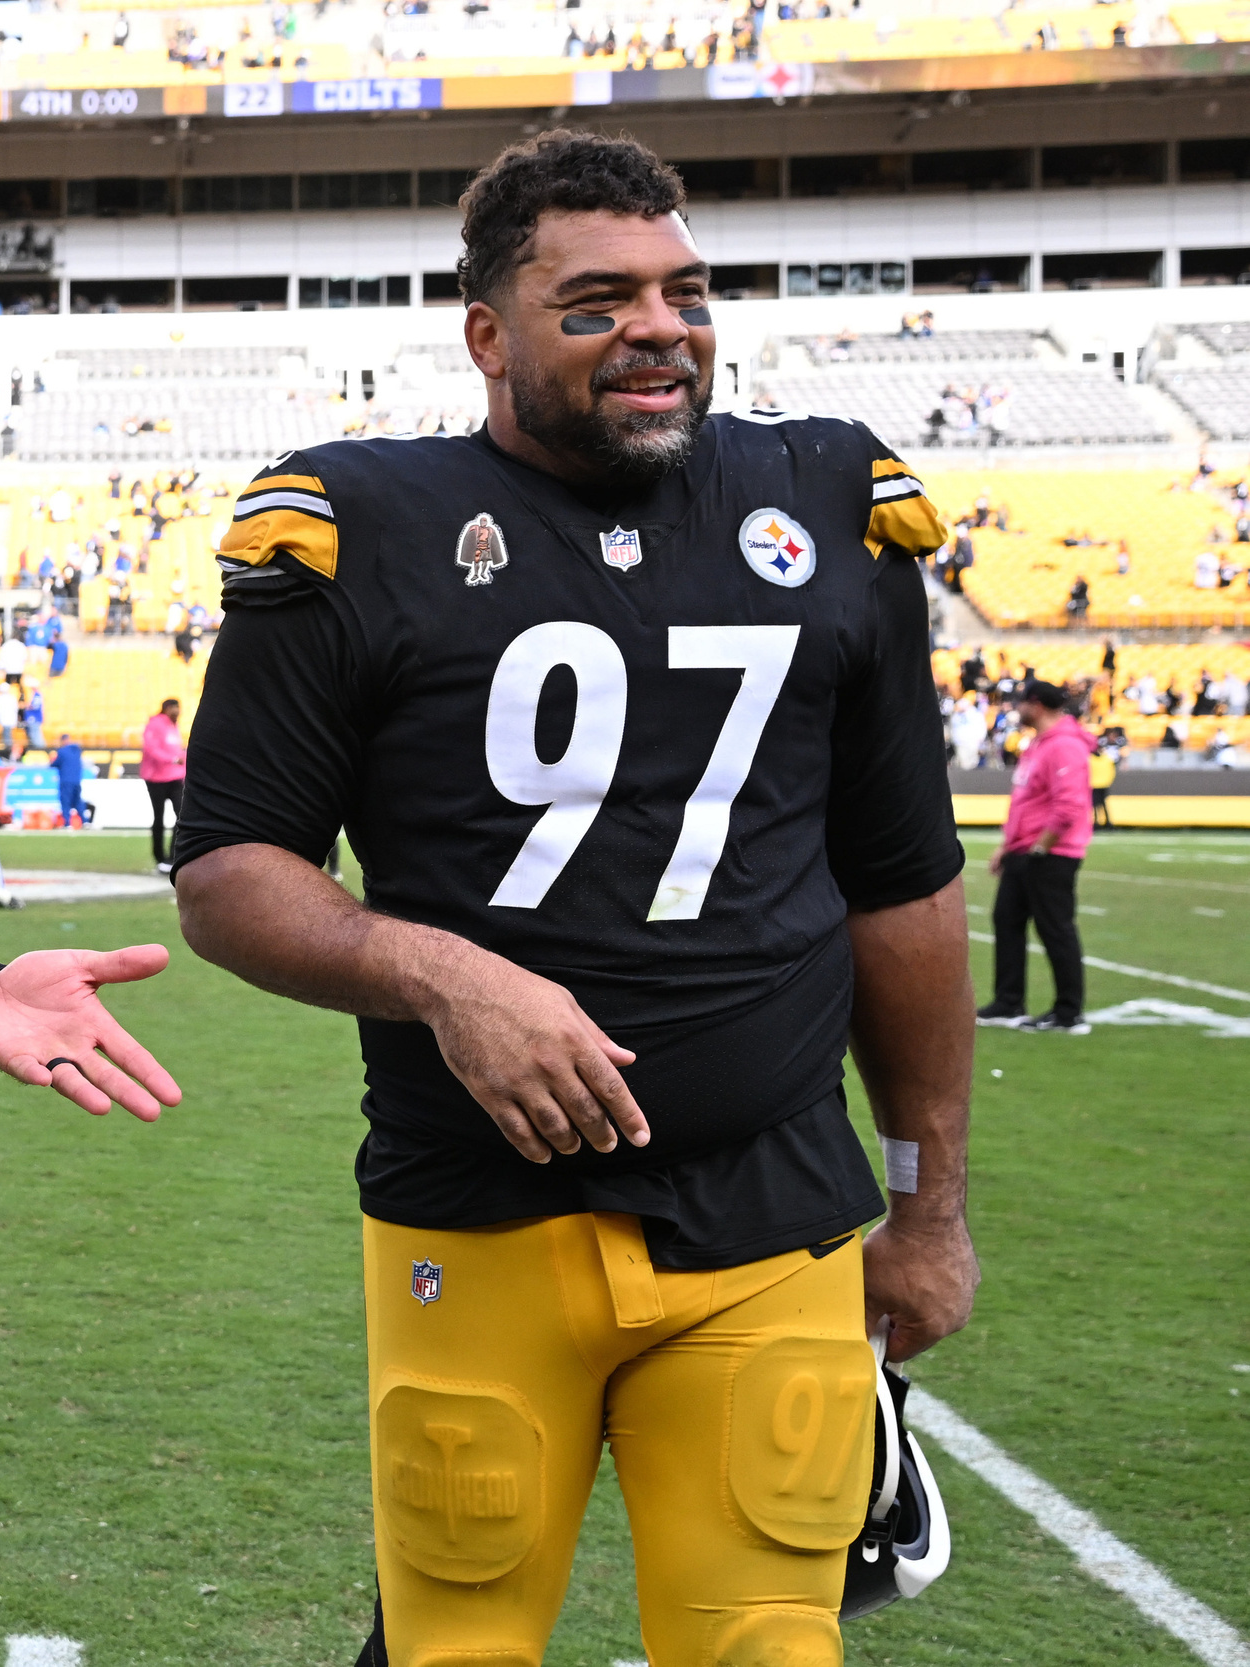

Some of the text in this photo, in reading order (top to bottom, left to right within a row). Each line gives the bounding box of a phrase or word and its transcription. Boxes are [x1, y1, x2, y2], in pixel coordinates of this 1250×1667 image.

[20, 88, 138, 116] 4TH 0:00
[238, 87, 269, 106] 22
[313, 78, 423, 110] COLTS
[610, 546, 636, 562] NFL
[747, 539, 778, 550] Steelers
[485, 621, 801, 921] 97
[414, 1277, 436, 1297] NFL
[773, 1370, 872, 1500] 97
